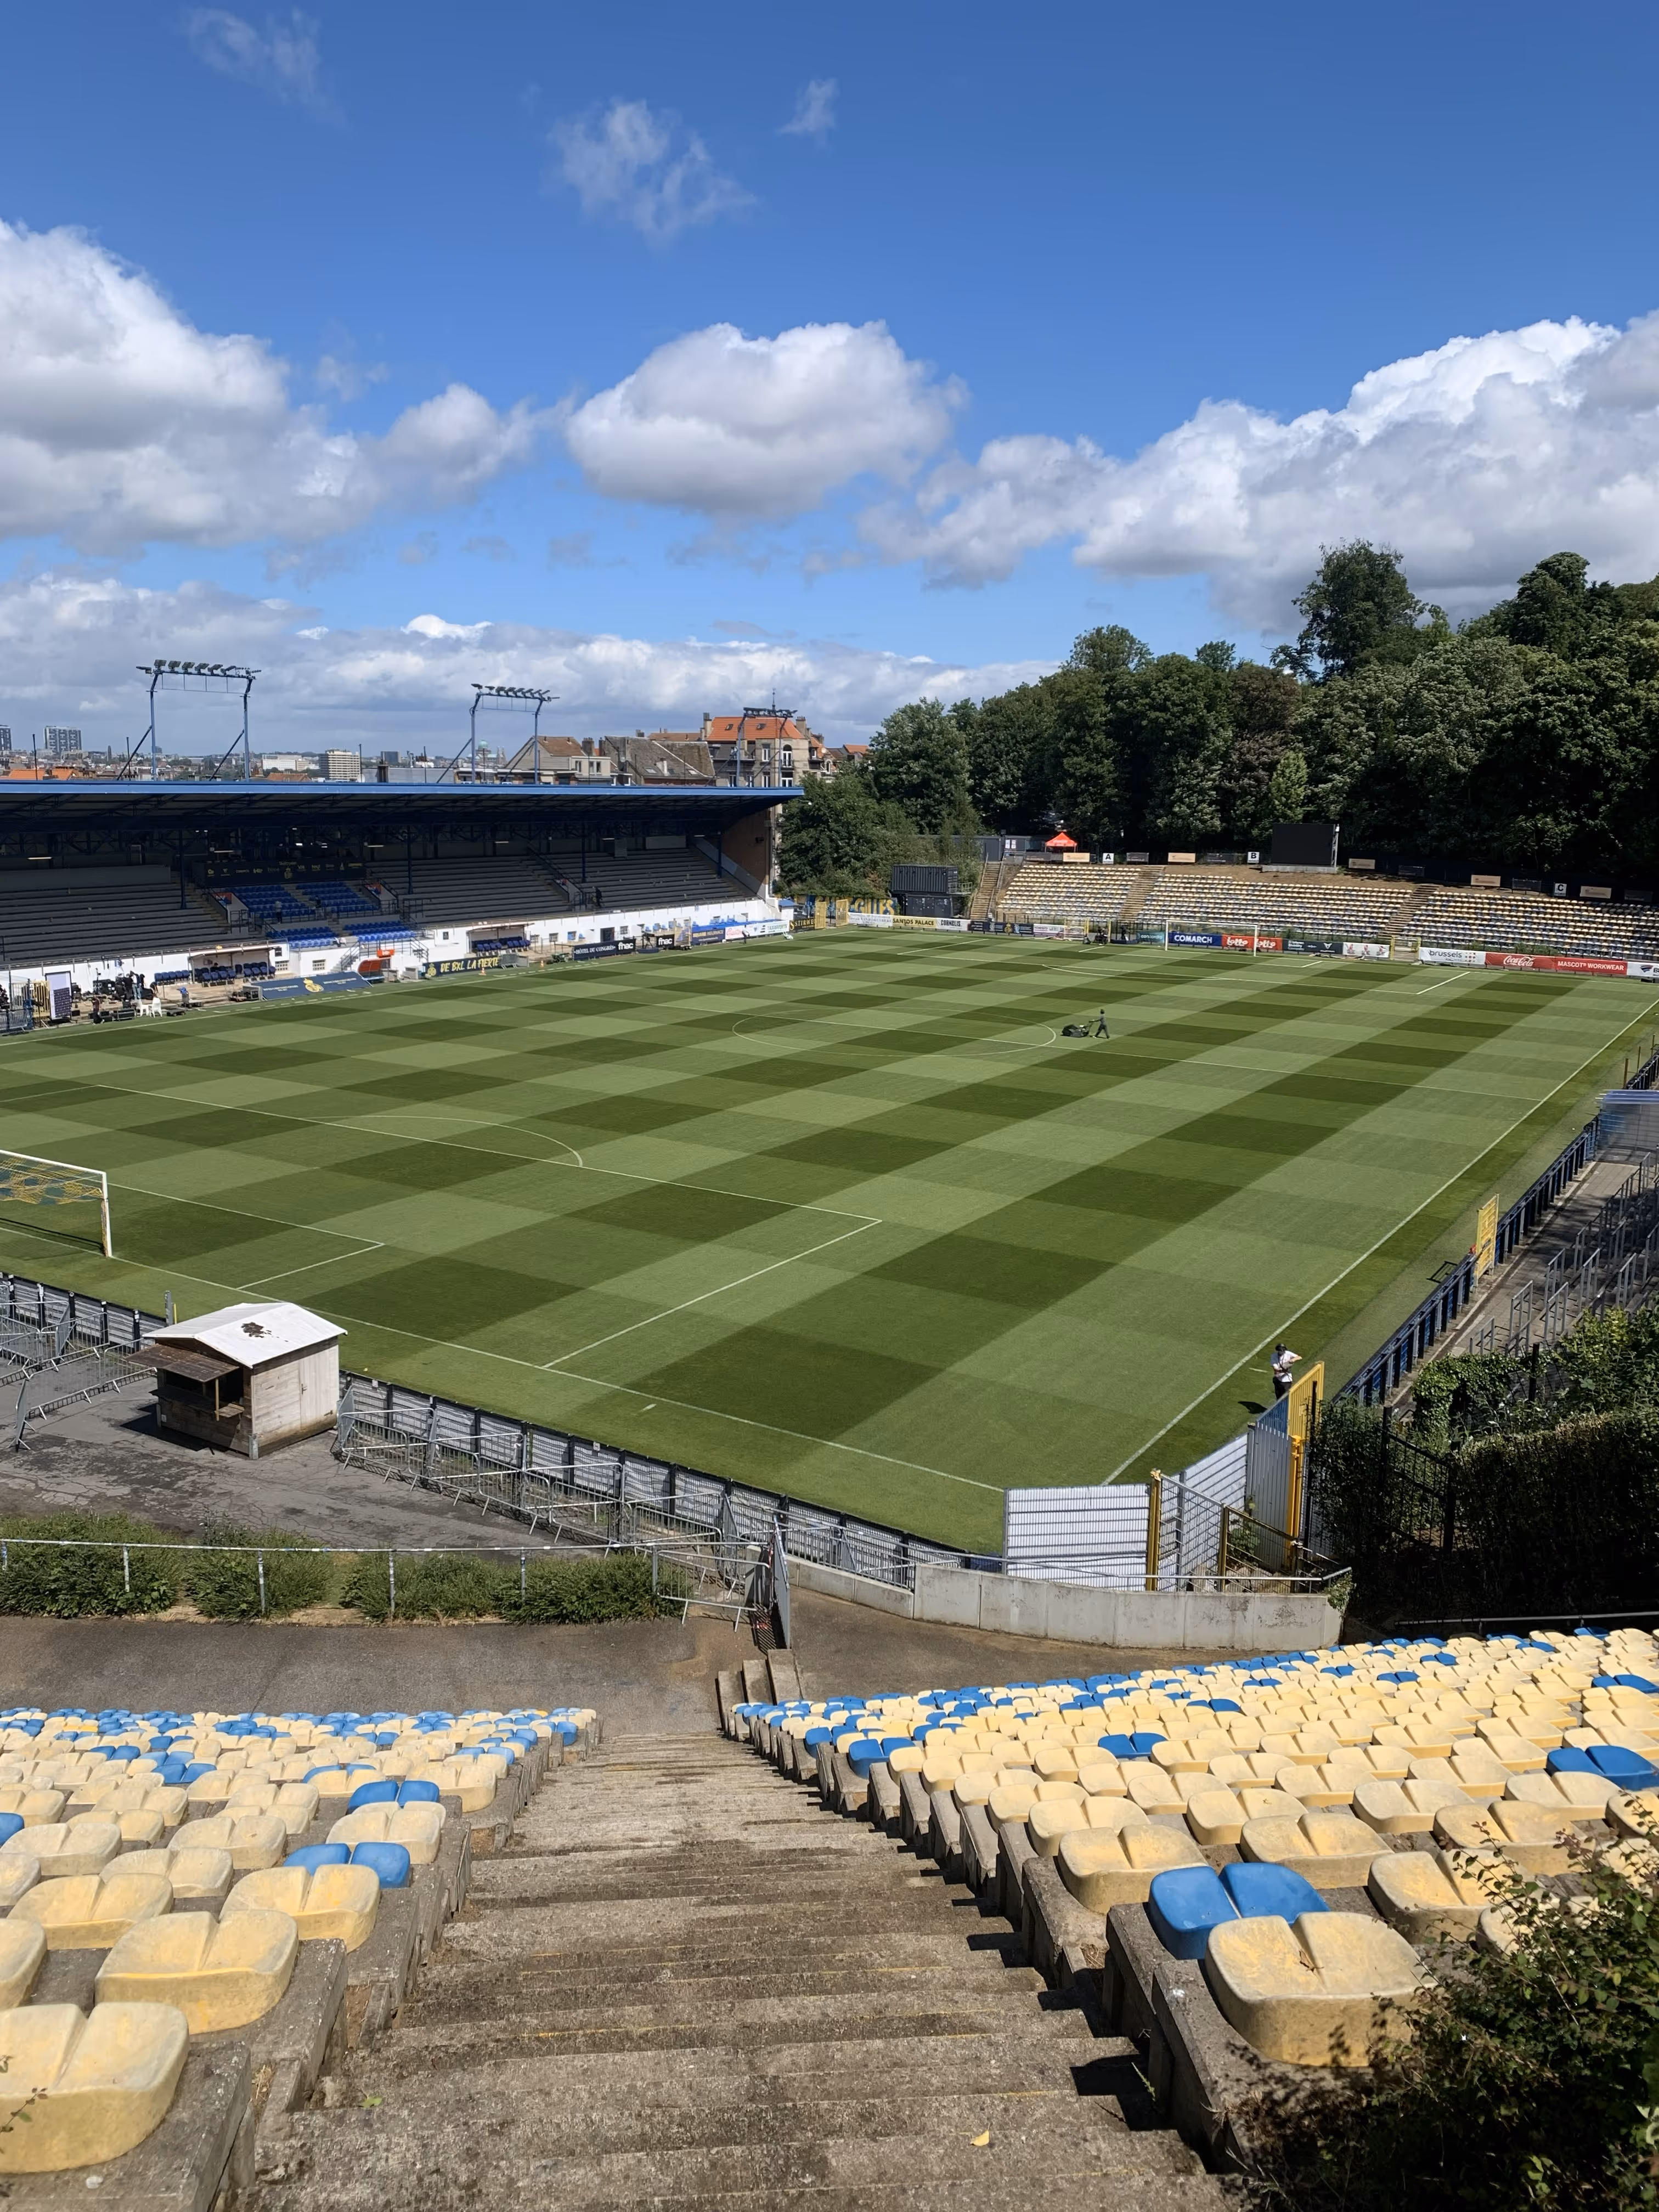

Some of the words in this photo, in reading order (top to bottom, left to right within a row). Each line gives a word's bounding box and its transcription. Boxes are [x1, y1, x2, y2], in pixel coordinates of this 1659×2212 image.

[795, 918, 815, 927] STIRWE
[1174, 934, 1212, 944] COMARCH
[618, 942, 634, 950] fnac
[1430, 950, 1462, 958] brussels
[440, 962, 450, 973] DE
[452, 961, 465, 972] BXL
[467, 960, 477, 969] LA
